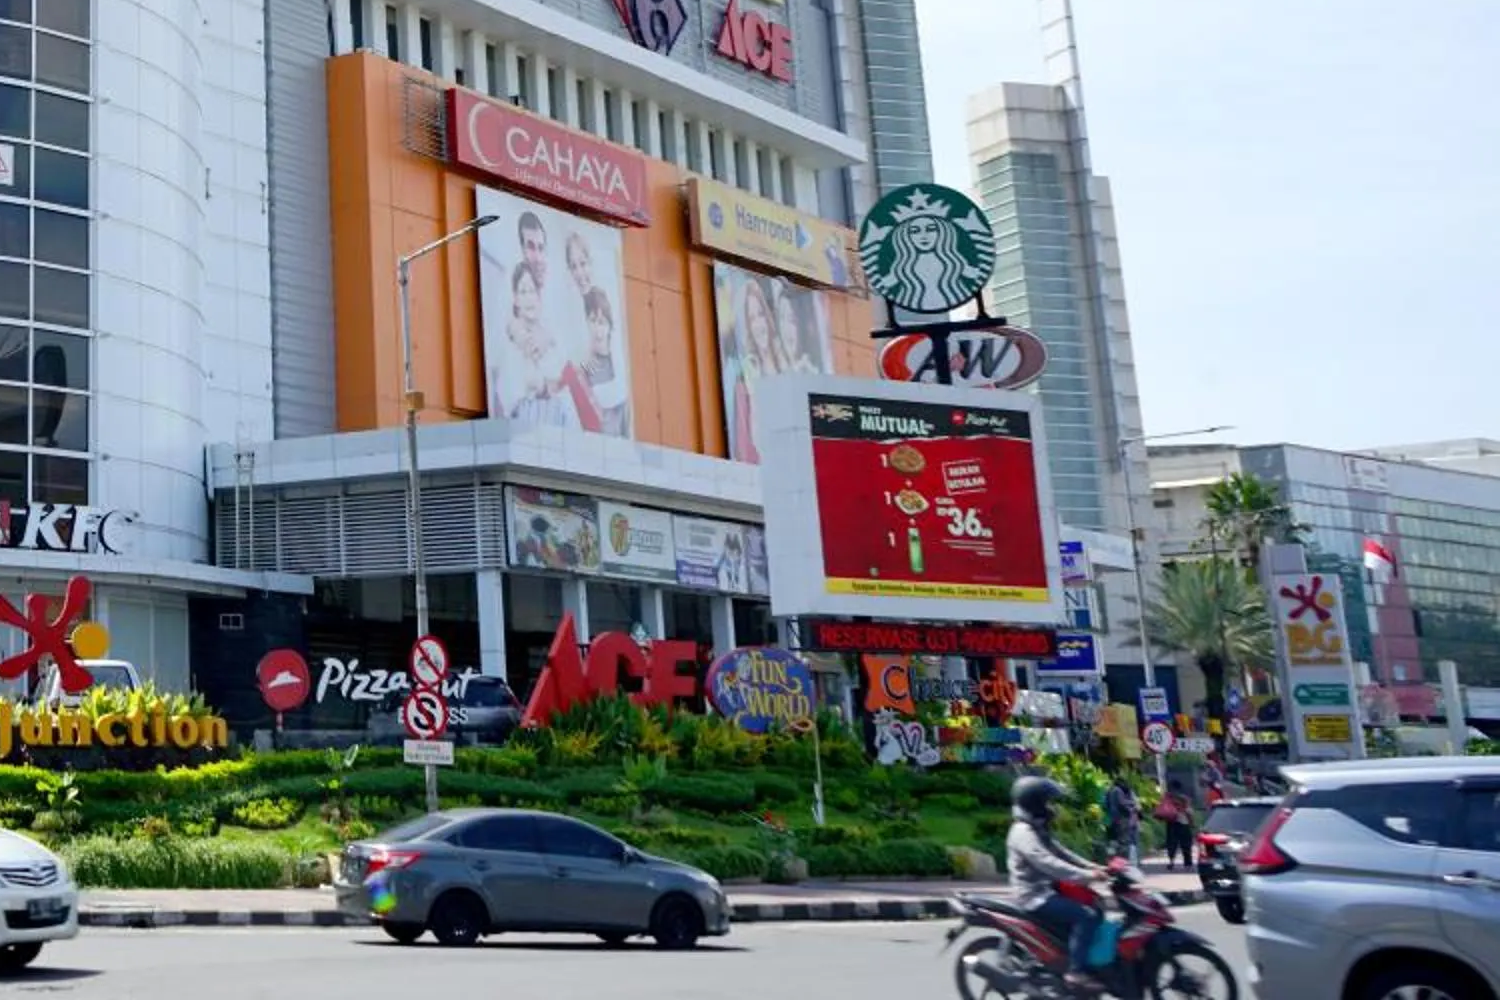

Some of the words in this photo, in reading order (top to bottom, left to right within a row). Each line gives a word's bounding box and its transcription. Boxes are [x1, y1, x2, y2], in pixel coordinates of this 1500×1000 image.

[506, 127, 631, 202] CAHAYA
[861, 415, 929, 436] MUTUAL
[18, 503, 138, 555] KFC
[316, 656, 411, 703] Pizza
[414, 666, 482, 699] ut
[521, 611, 698, 728] ACE
